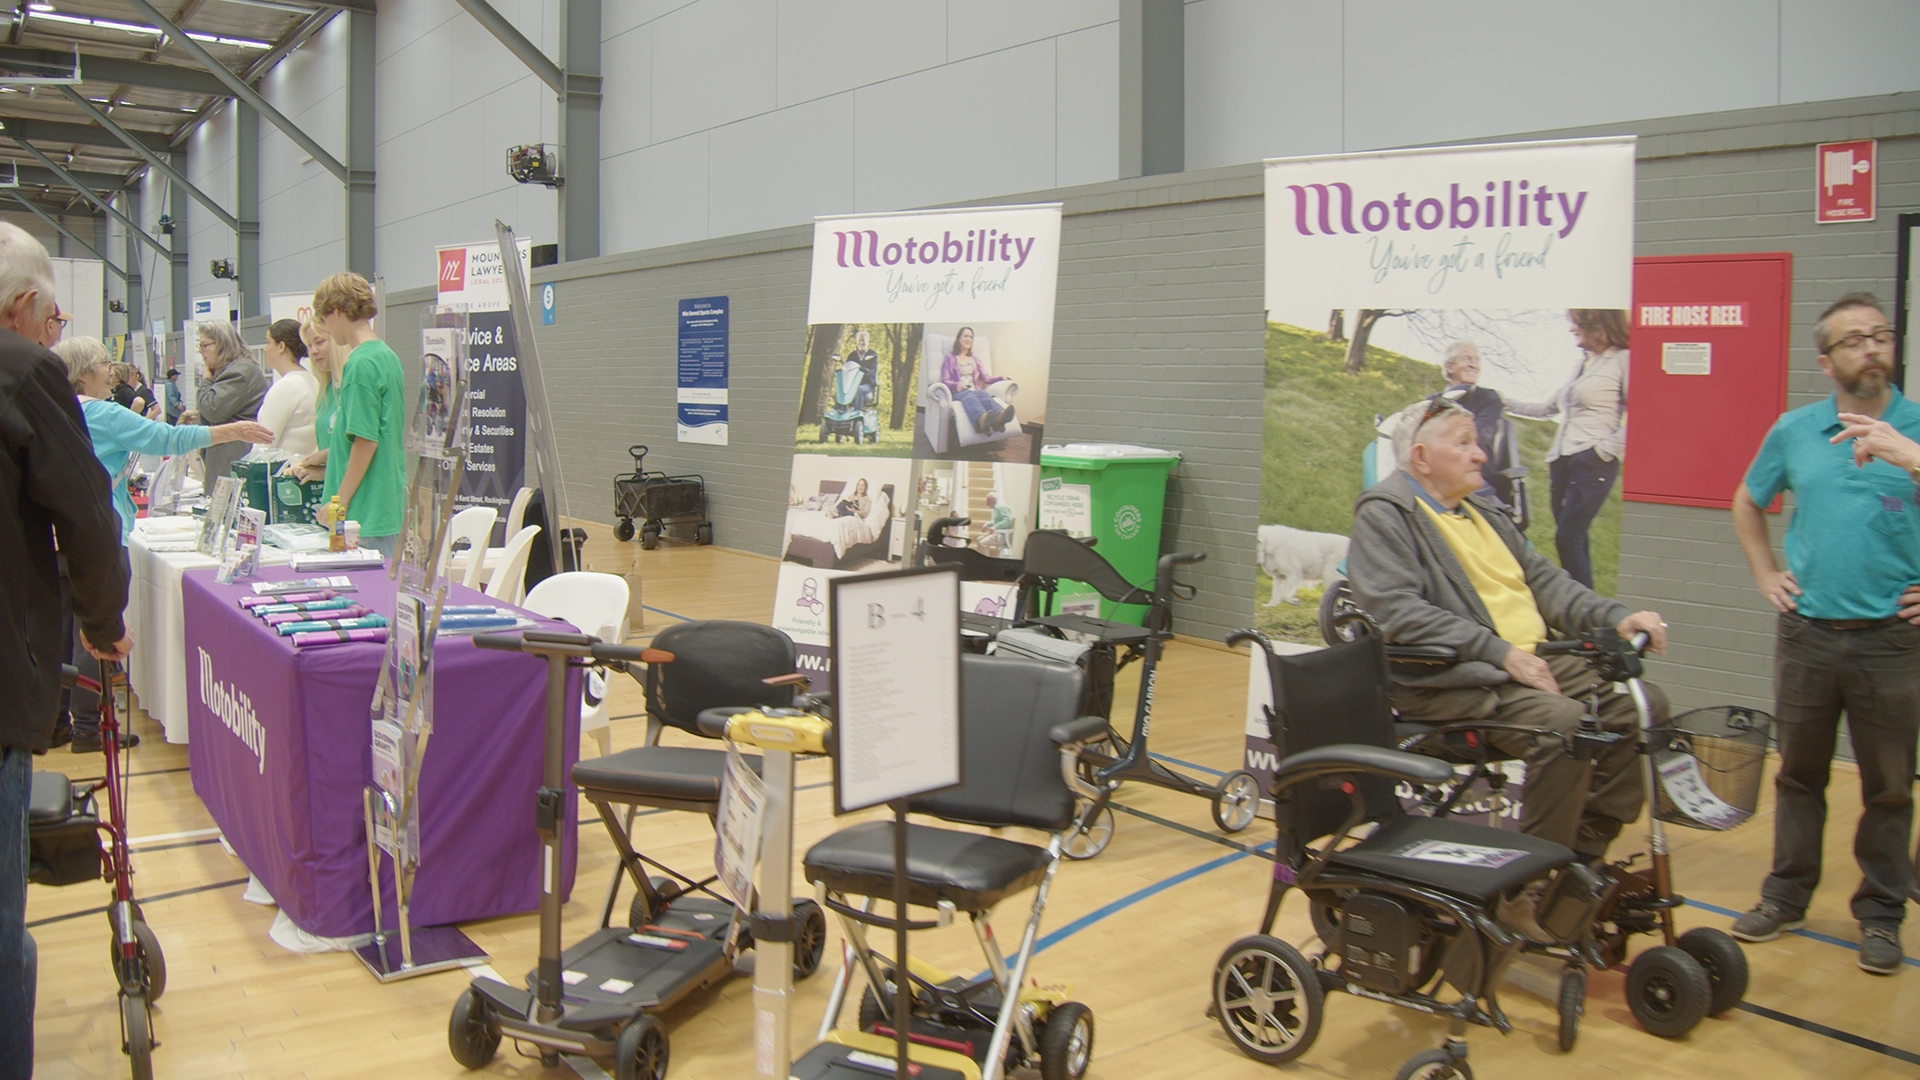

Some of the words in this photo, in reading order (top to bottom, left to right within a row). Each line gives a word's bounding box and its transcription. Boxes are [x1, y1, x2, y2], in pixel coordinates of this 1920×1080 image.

[1427, 235, 1475, 295] got
[1473, 252, 1485, 269] a
[1495, 232, 1555, 279] friend
[471, 265, 503, 276] LAWYE
[924, 268, 958, 311] got
[957, 279, 965, 293] a
[971, 266, 1012, 299] friend
[1641, 306, 1670, 326] FIRE
[1672, 305, 1709, 326] HOSE
[1710, 305, 1744, 325] REEL
[461, 326, 492, 345] dvice
[494, 326, 504, 345] &
[483, 354, 517, 371] Areas
[472, 407, 506, 418] Resolution
[475, 425, 481, 435] &
[481, 425, 515, 436] Securities
[469, 443, 494, 454] Estates
[467, 460, 496, 472] Services
[792, 617, 816, 627] Friendly
